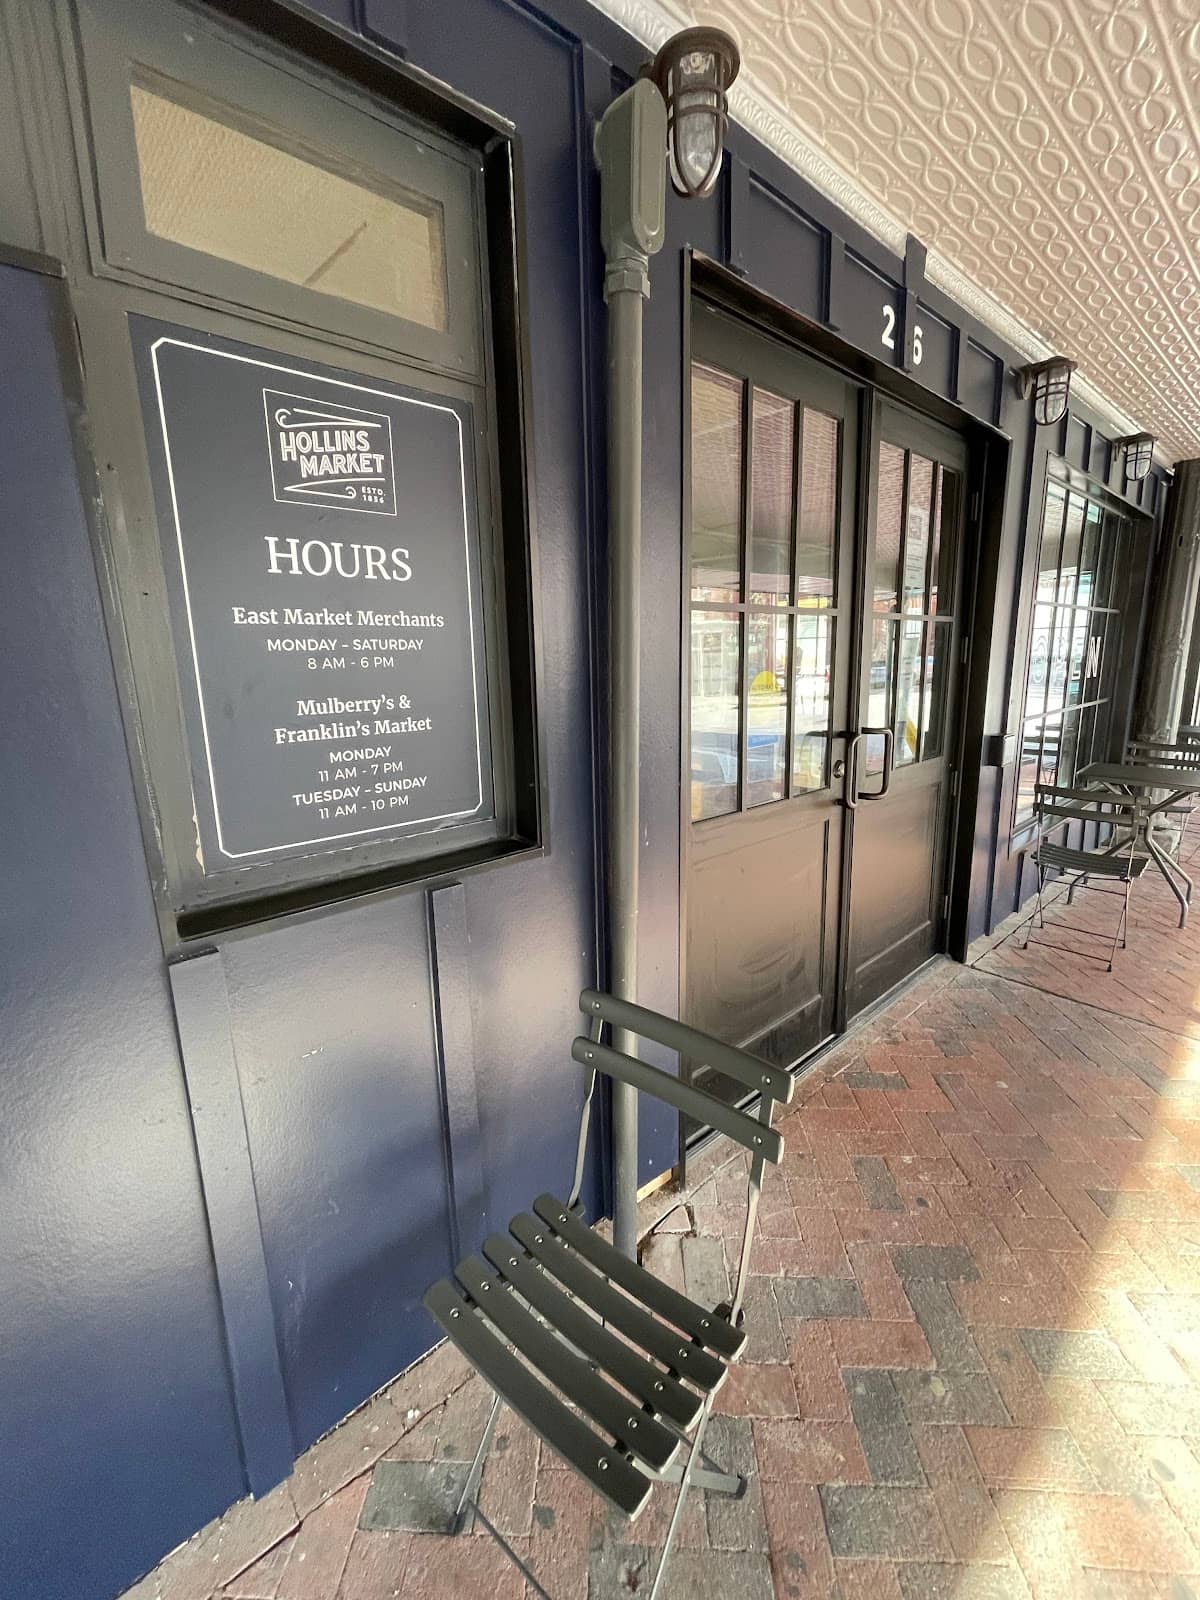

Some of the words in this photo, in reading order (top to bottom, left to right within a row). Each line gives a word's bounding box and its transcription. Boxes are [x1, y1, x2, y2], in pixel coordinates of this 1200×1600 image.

[279, 429, 371, 462] HOLLINS
[299, 452, 385, 478] MARKET
[264, 535, 413, 582] HOURS
[231, 606, 279, 625] East
[283, 607, 353, 626] Market
[357, 610, 445, 628] Merchants
[266, 638, 338, 652] MONDAY
[352, 638, 424, 651] SATURDAY
[307, 657, 318, 670] 8
[322, 656, 346, 670] AM
[360, 656, 369, 669] 6
[373, 655, 395, 668] PM
[296, 694, 395, 717] Mulberry's
[398, 694, 412, 710] &
[273, 719, 371, 745] Franklin's
[373, 716, 433, 736] Market
[329, 745, 392, 764] MONDAY
[317, 769, 329, 782] 11
[334, 766, 357, 781] AM
[370, 764, 379, 776] 7
[383, 761, 404, 774] PM
[292, 785, 361, 807] TUESDAY
[374, 776, 428, 794] SUNDAY
[318, 807, 330, 820] 11
[334, 803, 357, 818] AM
[370, 798, 386, 812] 10
[389, 795, 409, 809] PM
